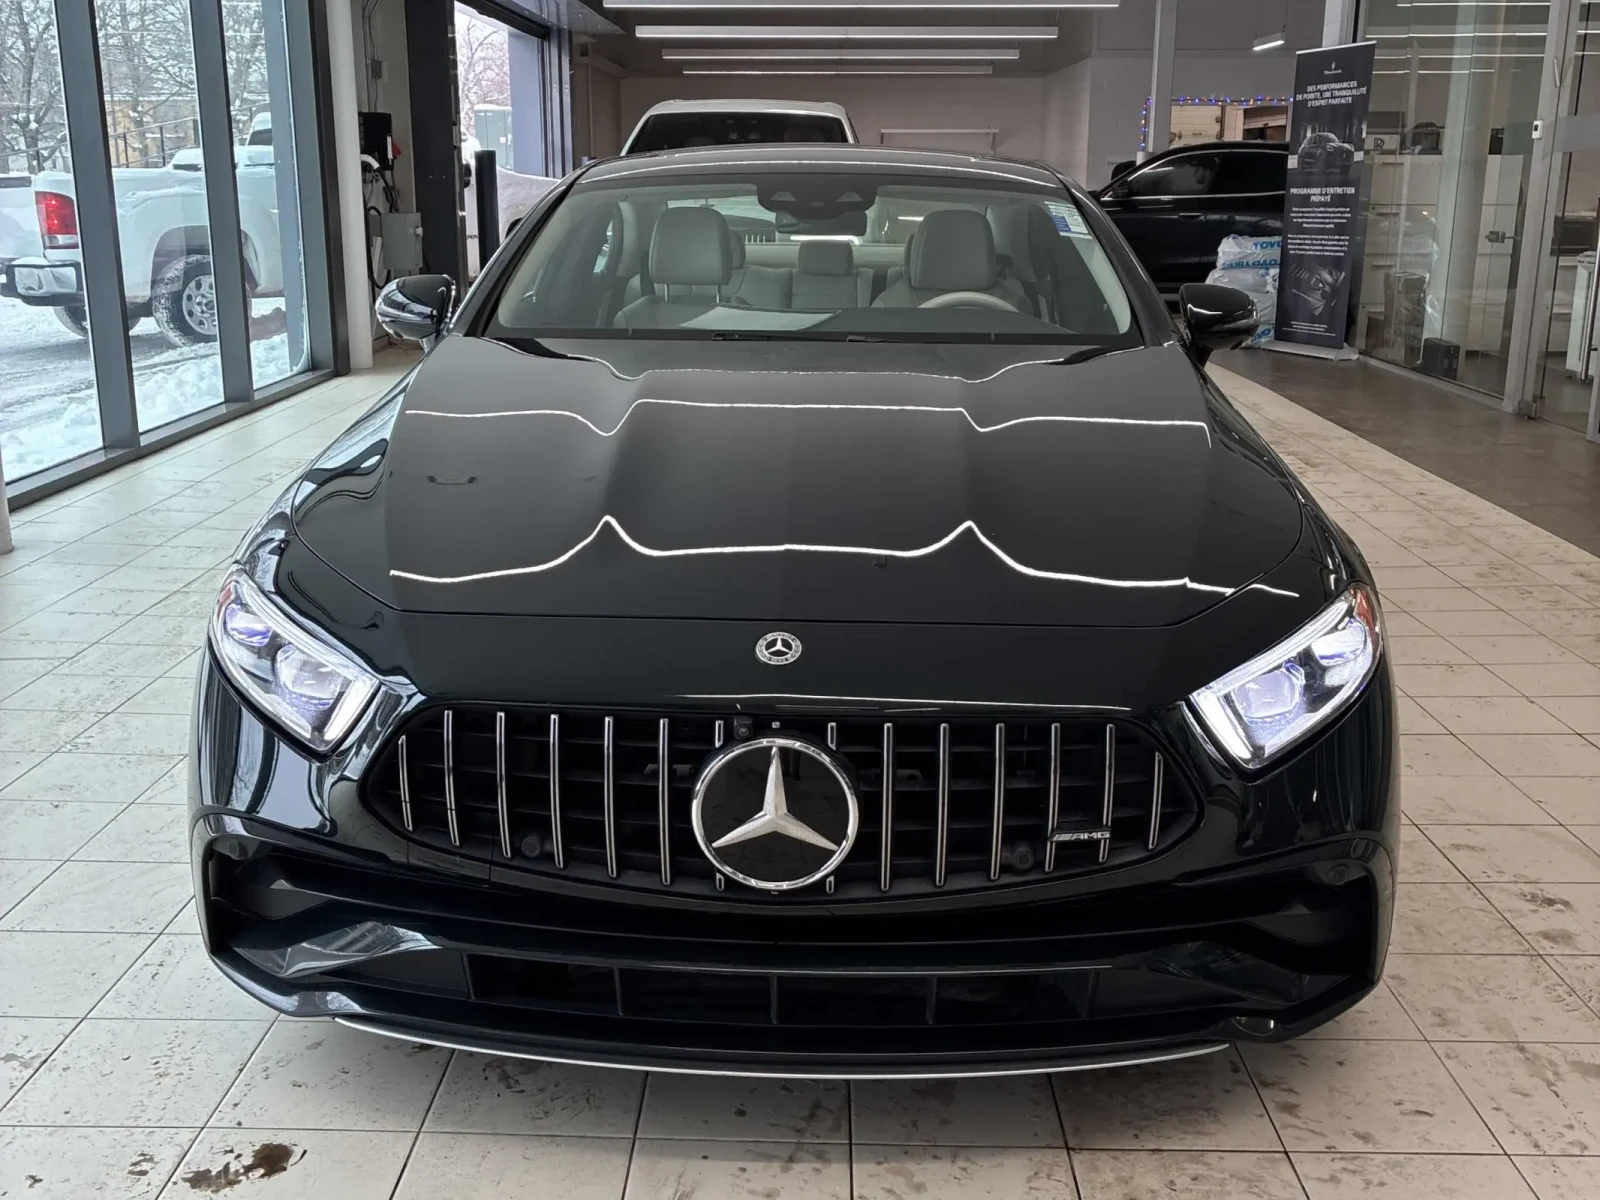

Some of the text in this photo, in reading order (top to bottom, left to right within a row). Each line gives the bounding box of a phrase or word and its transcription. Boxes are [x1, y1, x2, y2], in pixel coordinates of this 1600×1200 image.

[1317, 81, 1357, 91] PERFORMANCES
[1296, 93, 1303, 101] DE
[1328, 97, 1353, 105] PARFAITE
[1290, 186, 1356, 195] PROGRAMME D'ENTRETIEN
